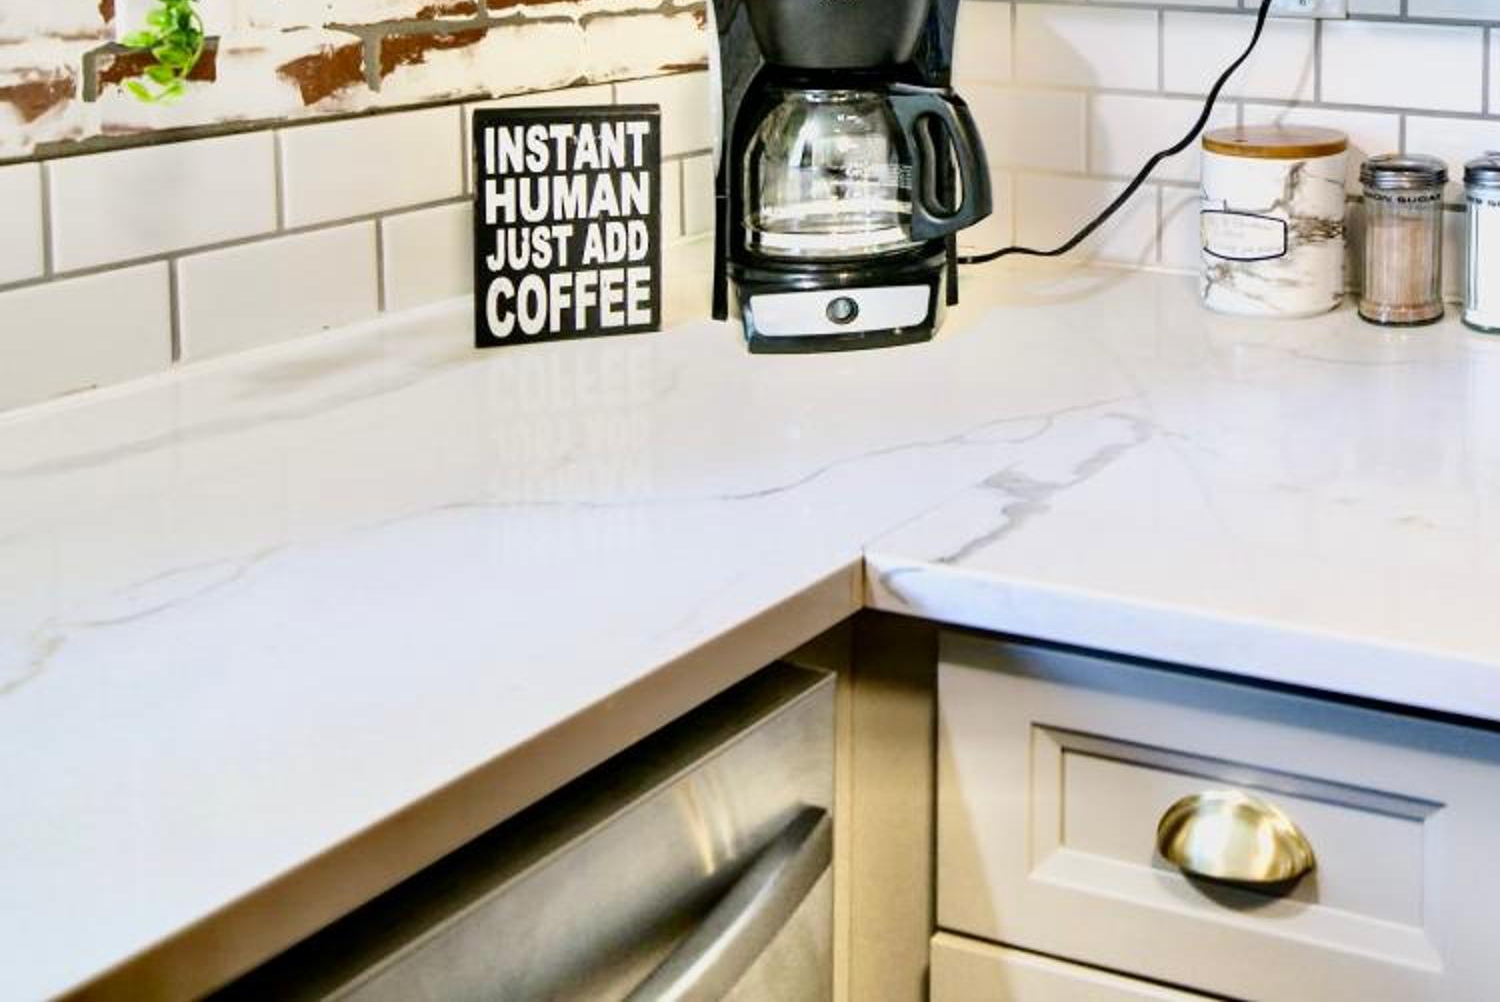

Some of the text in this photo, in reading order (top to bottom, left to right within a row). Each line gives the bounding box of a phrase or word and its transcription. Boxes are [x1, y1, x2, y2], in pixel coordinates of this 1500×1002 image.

[484, 121, 650, 175] INSTANT
[485, 172, 650, 224] HUMAN
[486, 220, 650, 272] JUST ADD
[486, 266, 651, 338] COFFEE
